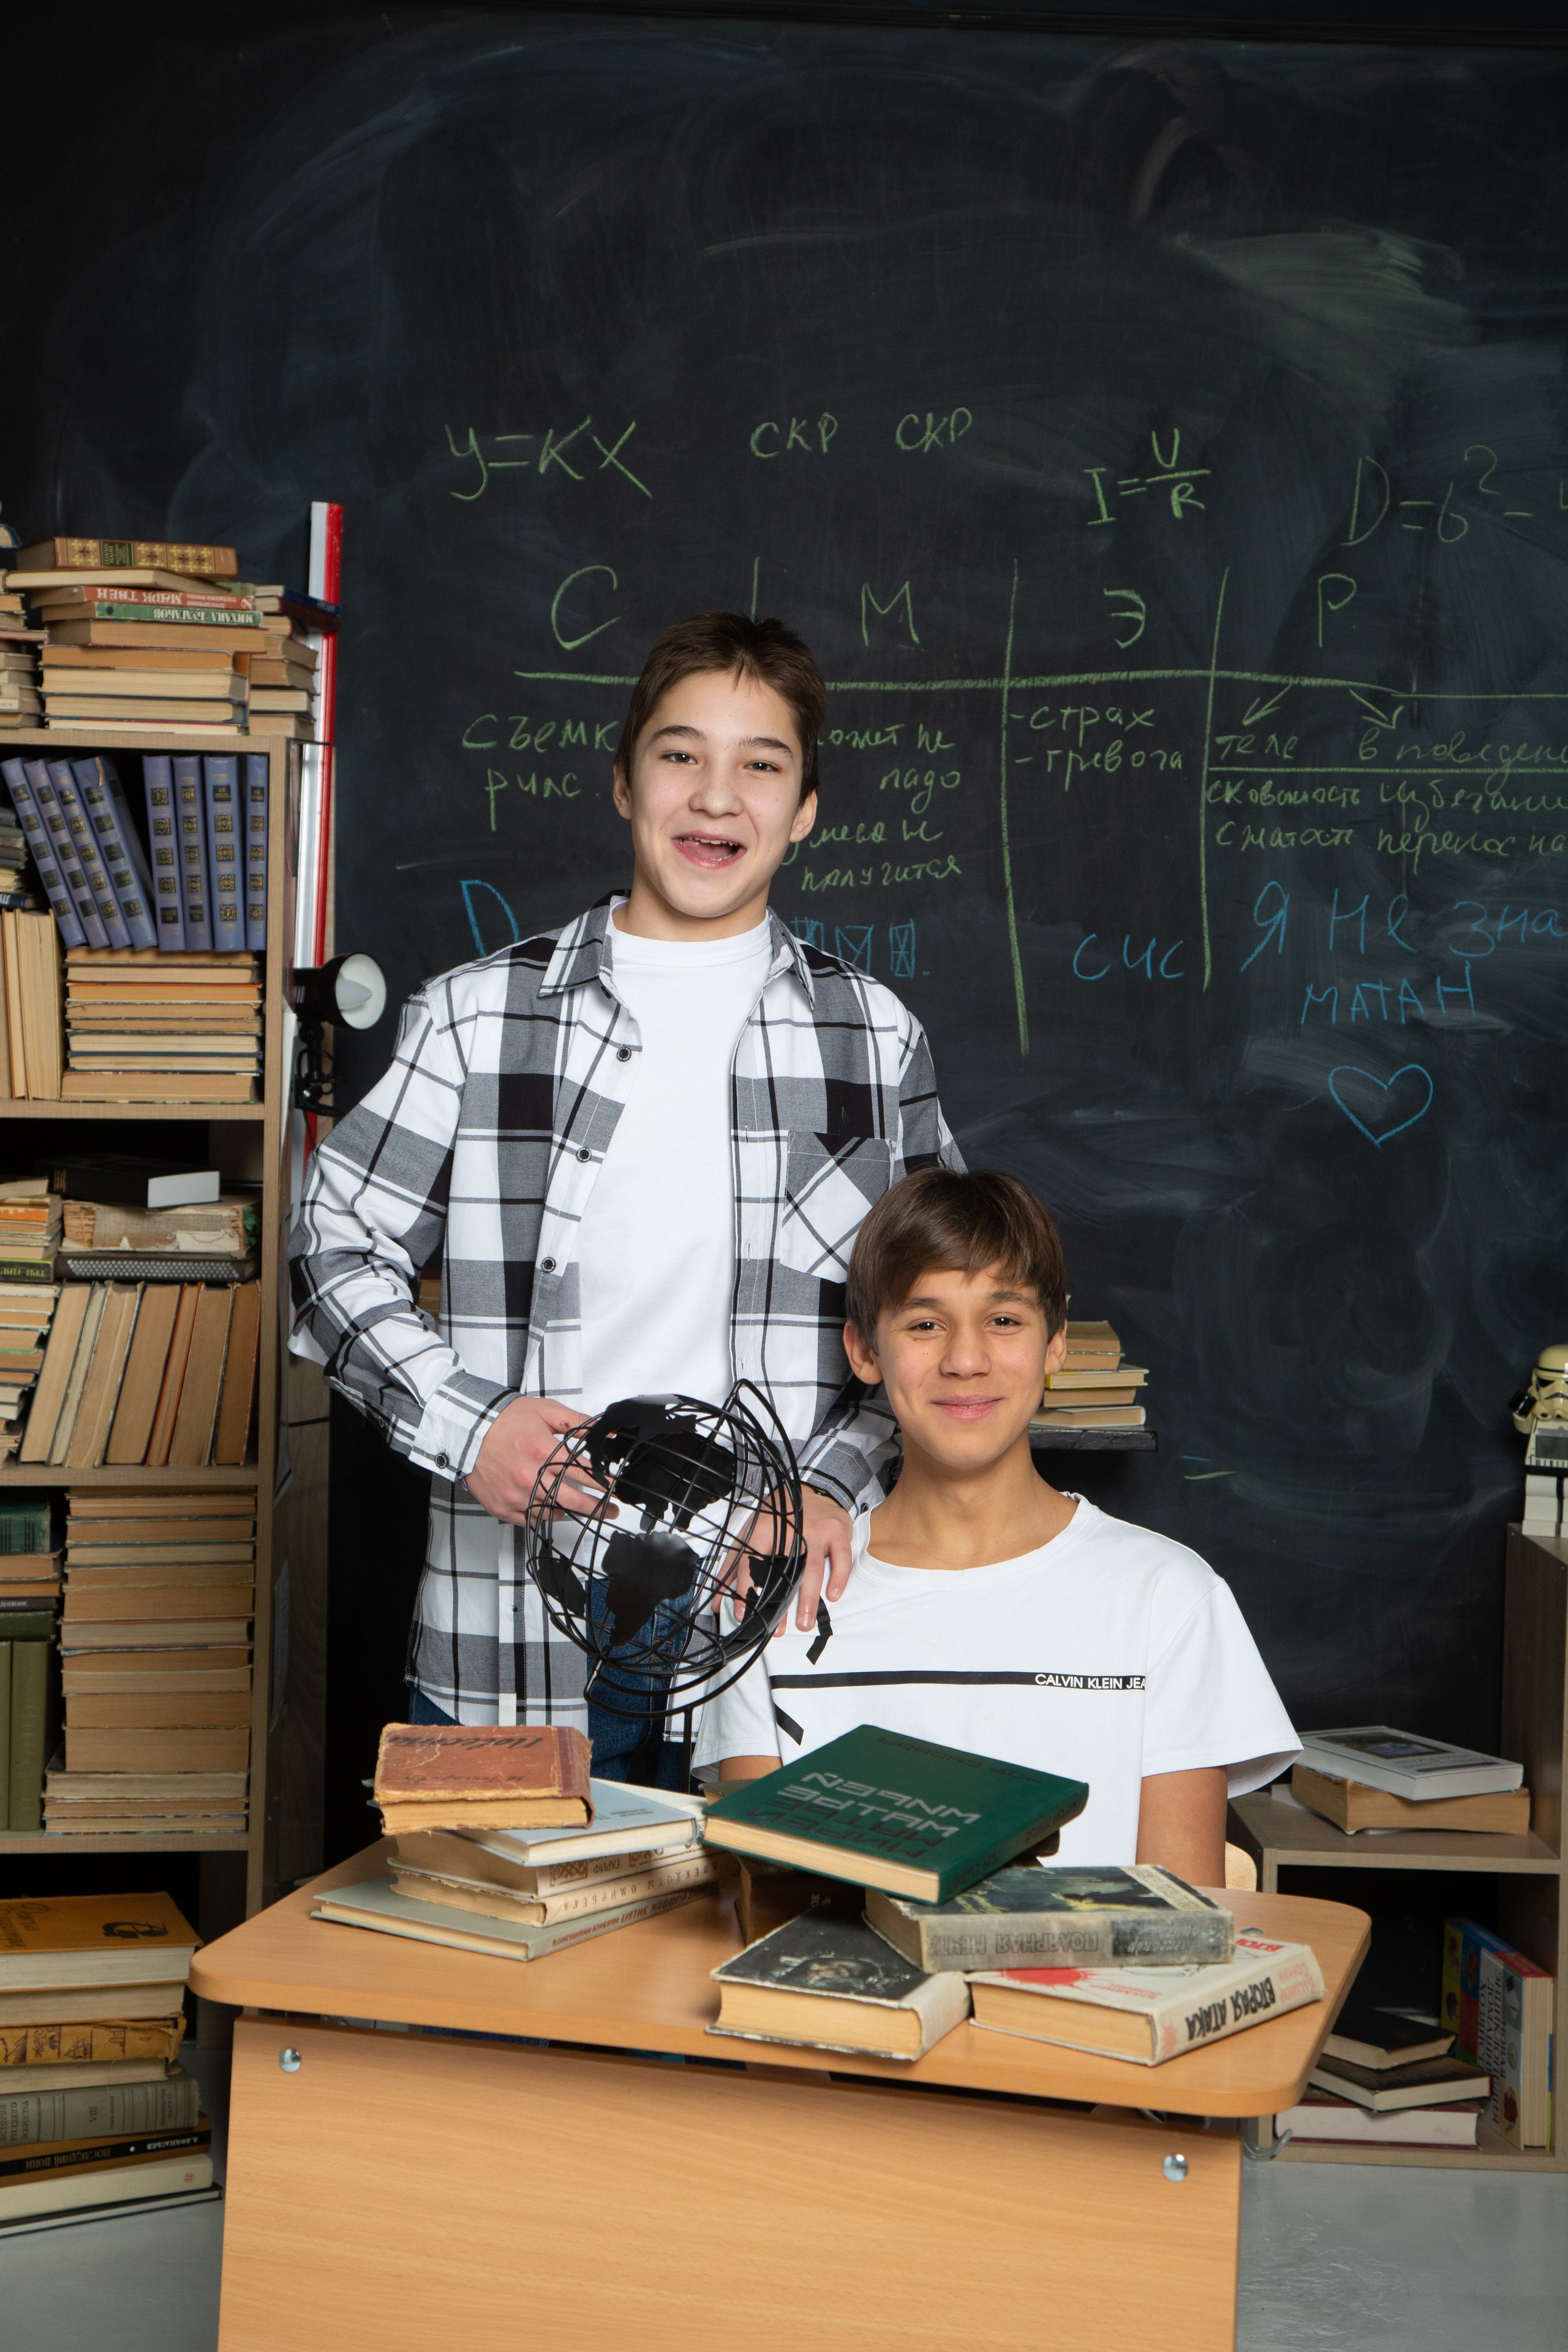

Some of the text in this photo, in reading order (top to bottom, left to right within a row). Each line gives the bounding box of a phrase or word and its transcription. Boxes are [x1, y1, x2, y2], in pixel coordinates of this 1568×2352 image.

[211, 612, 254, 623] МИХАИЛ
[1105, 588, 1145, 648] Э
[462, 714, 619, 753] Съемк
[1240, 881, 1290, 973] Я
[1035, 1673, 1083, 1689] CALVIN
[1087, 1676, 1123, 1690] KLEIN
[1186, 1995, 1227, 2041] АТАКА
[1232, 1975, 1276, 2021] ВТОРАЯ
